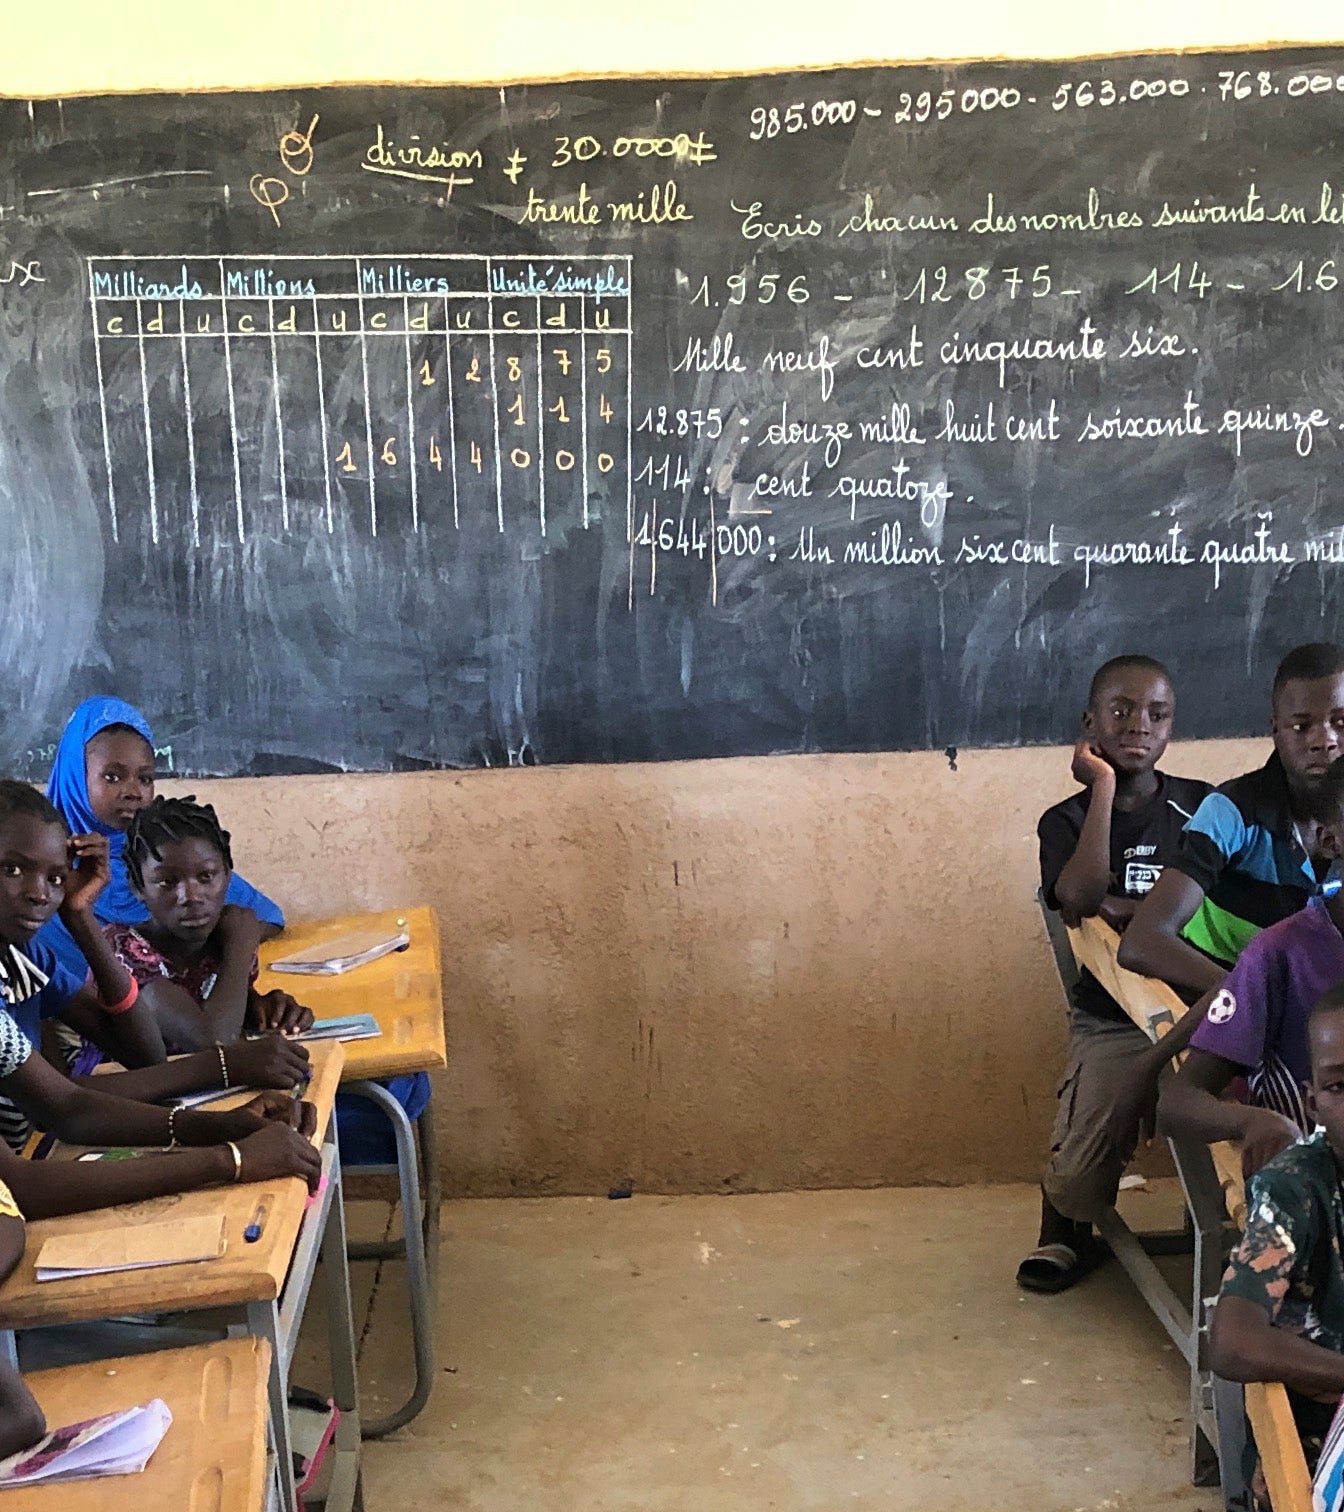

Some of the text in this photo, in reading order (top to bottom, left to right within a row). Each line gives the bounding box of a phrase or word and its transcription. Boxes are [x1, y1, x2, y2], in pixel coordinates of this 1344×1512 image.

[750, 100, 857, 140] 985.000
[1052, 78, 1190, 111] 563.000
[367, 125, 483, 168] division
[517, 180, 694, 225] trente mille
[839, 195, 958, 238] chacun
[1152, 184, 1266, 228] suivants
[1267, 200, 1306, 223] en
[227, 267, 316, 298] Millions
[363, 265, 449, 294] Milliers
[552, 265, 630, 304] simple
[690, 264, 811, 308] 1.956
[107, 302, 610, 334] c d u c d u c d u c d u
[674, 333, 747, 373] Mille
[763, 336, 838, 401] neuf
[856, 324, 925, 370] cent
[940, 317, 1106, 388] cinquante
[758, 401, 853, 468] douze
[859, 403, 926, 445] mille
[935, 398, 998, 443] huit
[1005, 399, 1061, 442] cent
[1078, 390, 1208, 442] soixante
[748, 460, 813, 501] cent
[789, 526, 836, 565] Un
[843, 526, 945, 566] million
[1011, 523, 1061, 565] cent
[1073, 519, 1195, 589] quarante
[1200, 516, 1295, 589] quatre
